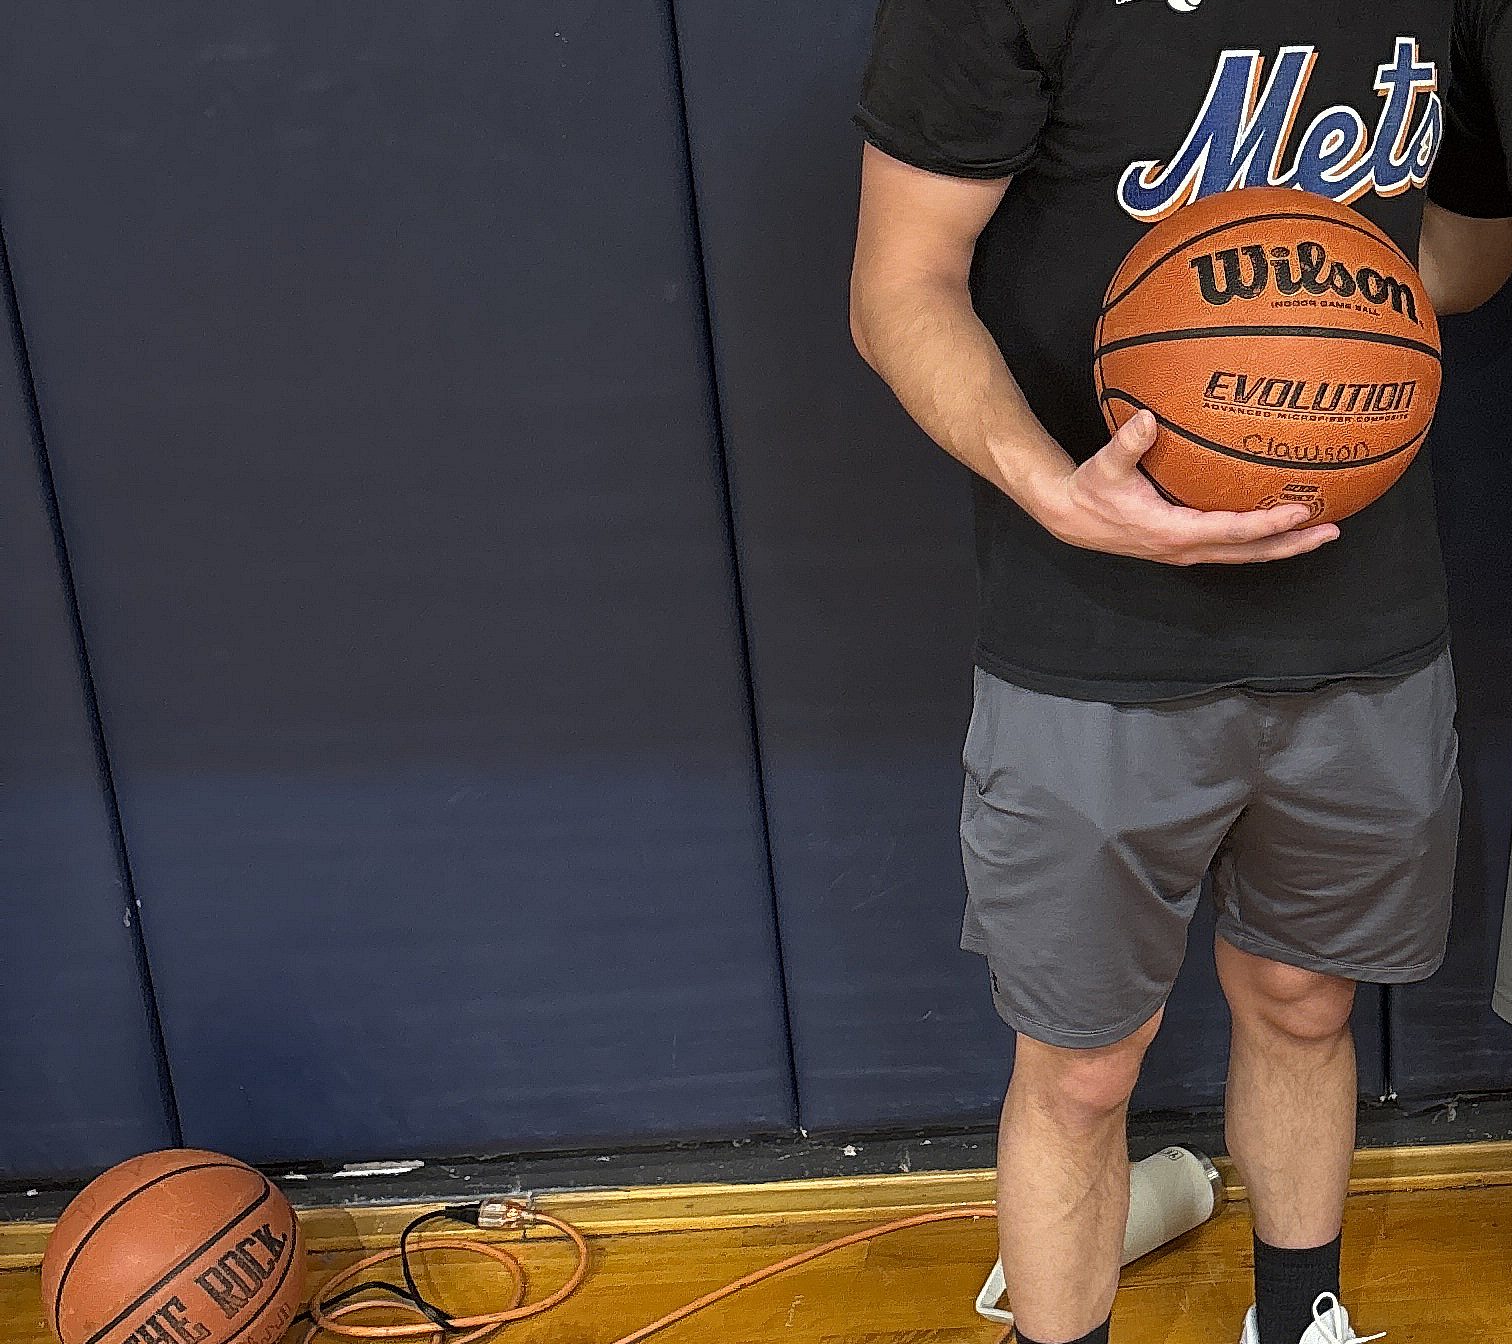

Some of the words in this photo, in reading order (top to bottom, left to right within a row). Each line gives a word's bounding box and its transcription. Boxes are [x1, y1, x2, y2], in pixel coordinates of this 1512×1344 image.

[1117, 35, 1444, 223] Mets
[1188, 240, 1420, 327] Wilson
[1201, 402, 1271, 418] ADVANCED
[1203, 371, 1416, 412] EVOLUTION
[1242, 433, 1371, 462] Clawson
[193, 1223, 286, 1320] ROCK
